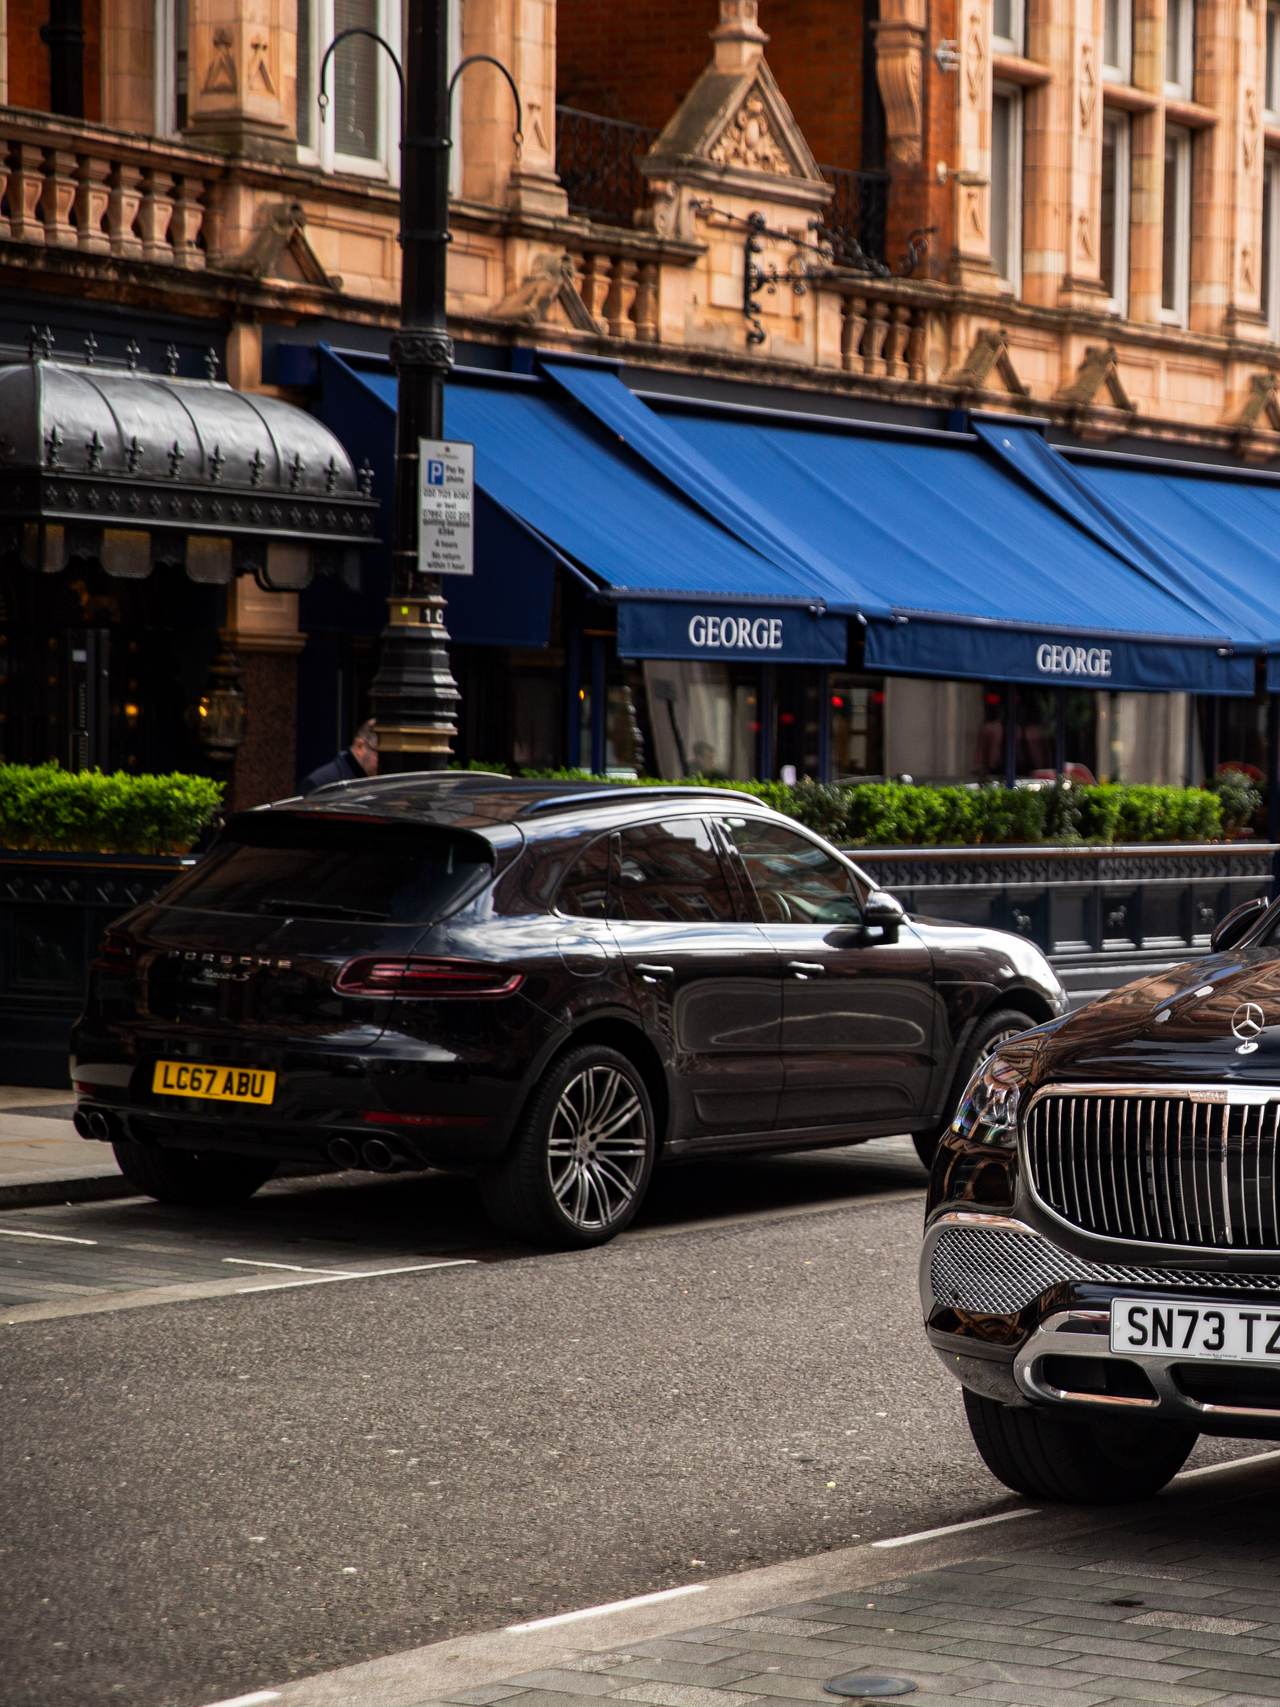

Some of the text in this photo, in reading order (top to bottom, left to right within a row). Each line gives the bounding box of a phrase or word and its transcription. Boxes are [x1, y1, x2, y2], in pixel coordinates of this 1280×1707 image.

[688, 614, 783, 650] GEORGE
[1036, 643, 1112, 678] GEORGE
[167, 949, 293, 969] PORSCHE
[162, 1064, 266, 1099] LC67 ABU
[1127, 1305, 1226, 1351] SN73
